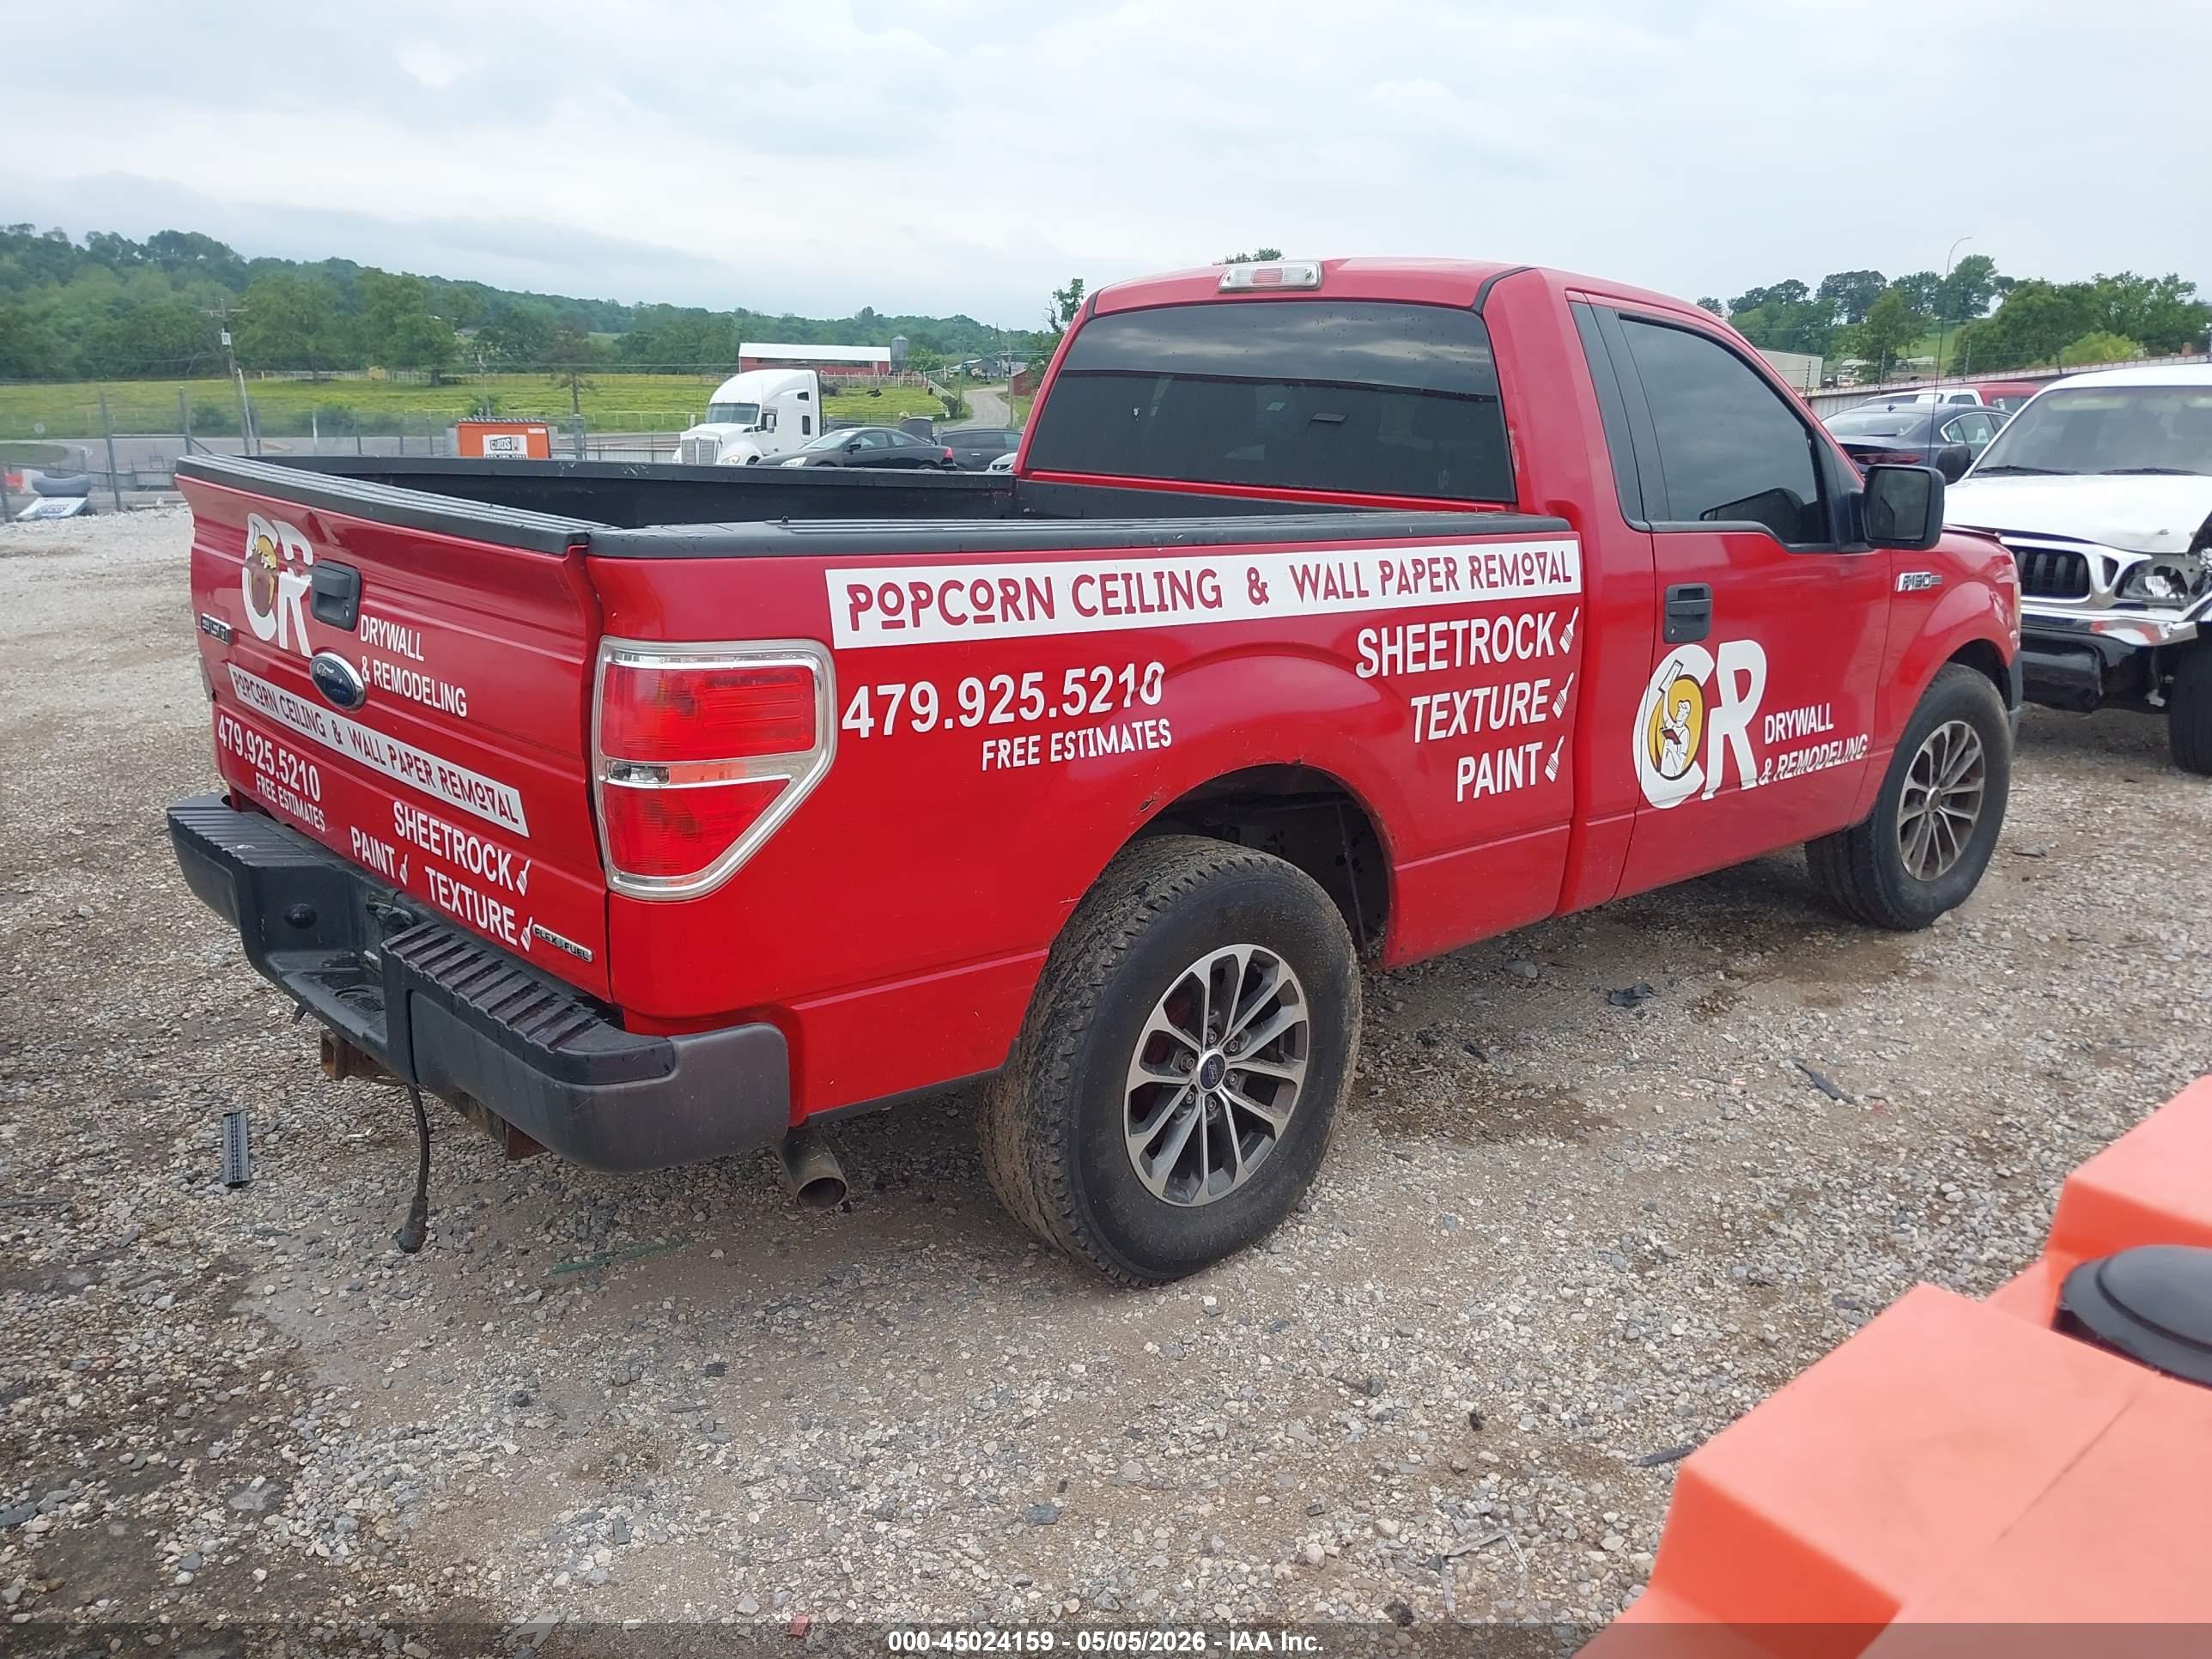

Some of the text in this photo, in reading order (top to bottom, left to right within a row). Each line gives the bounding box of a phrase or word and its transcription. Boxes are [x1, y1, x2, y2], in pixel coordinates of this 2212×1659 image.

[846, 550, 1572, 632] POPCORN CEILING & WALL PAPER REMOVAL
[361, 614, 424, 662] DRYWALL
[1355, 611, 1556, 678] SHEETROCK
[362, 655, 370, 683] &
[373, 659, 467, 717] REMODELING
[842, 661, 1166, 738] 479.925.5210
[1410, 678, 1551, 744] TEXTURE
[233, 671, 280, 715] POPCORN
[279, 694, 327, 738] CEILING
[331, 719, 343, 745] &
[347, 726, 386, 766] WALL
[386, 743, 436, 788] PAPER
[437, 765, 520, 824] REMOVAL
[981, 718, 1172, 771] FREE ESTIMATES
[1764, 702, 1834, 745] DRYWALL
[218, 714, 321, 802] 479.925.5210
[1456, 741, 1542, 802] PAINT
[1759, 733, 1869, 785] & REMODELING
[255, 772, 326, 832] FREE ESTIMATES
[350, 825, 395, 878] PAINT
[393, 801, 514, 891] SHEETROCK
[425, 866, 518, 946] TEXTURE
[534, 927, 589, 961] FLEX FUEL
